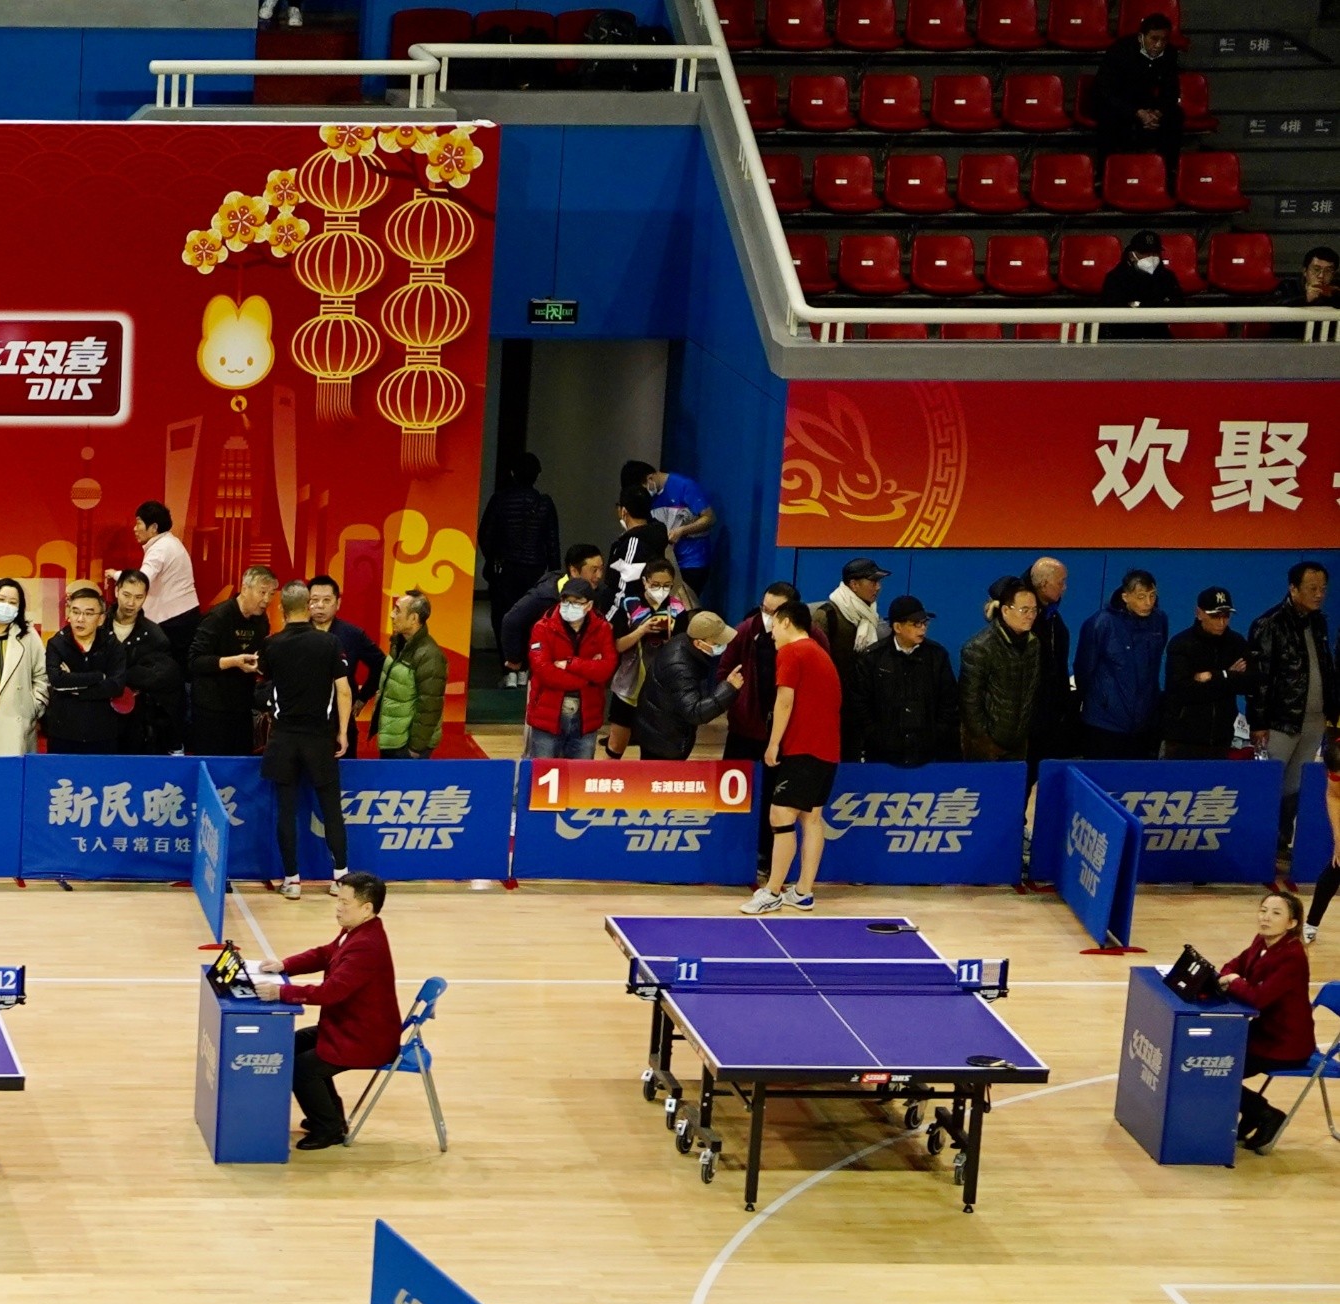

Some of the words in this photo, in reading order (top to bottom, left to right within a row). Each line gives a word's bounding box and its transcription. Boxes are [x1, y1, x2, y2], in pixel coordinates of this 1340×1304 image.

[1280, 121, 1301, 132] 4排
[1312, 201, 1333, 213] 3排
[25, 378, 102, 401] DHS
[1091, 416, 1340, 515] 欢聚
[538, 769, 560, 804] 1
[585, 778, 625, 794] 麒麟寺
[719, 769, 748, 805] 0
[822, 788, 980, 841] 红双喜
[376, 827, 465, 850] DHS
[624, 829, 711, 853] DHS
[886, 829, 973, 853] DHS
[678, 963, 699, 982] 11
[959, 963, 980, 982] 11
